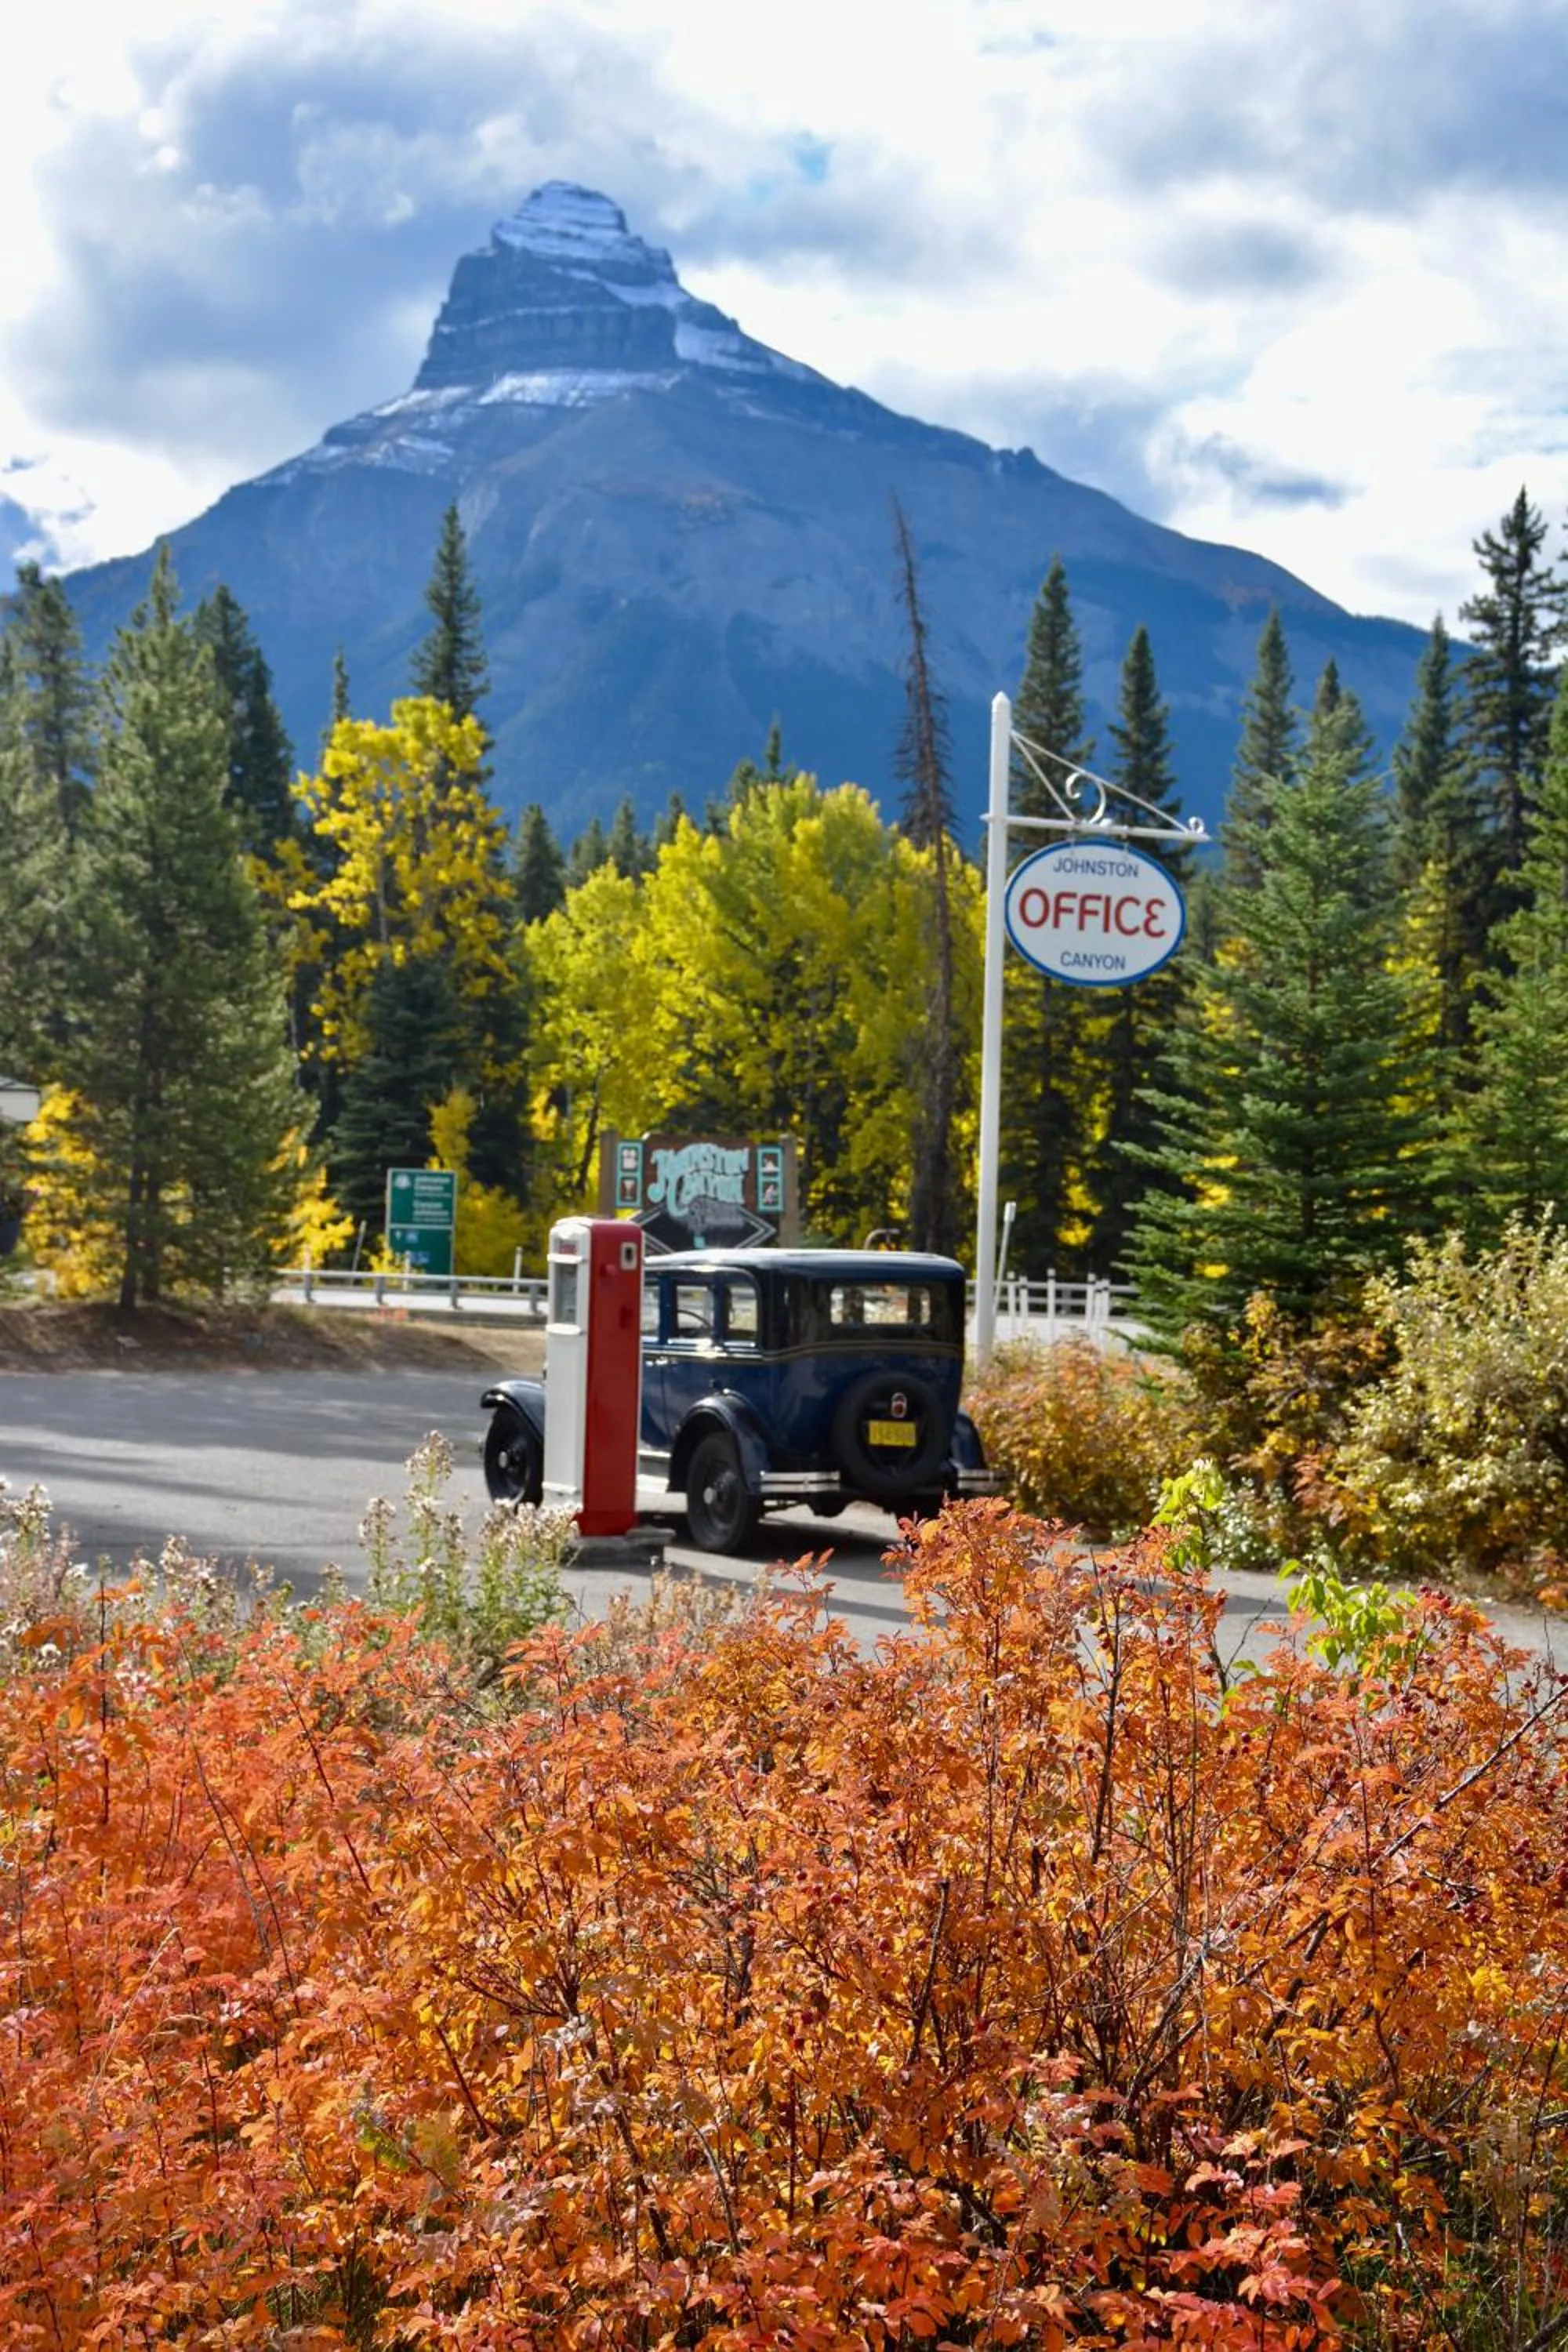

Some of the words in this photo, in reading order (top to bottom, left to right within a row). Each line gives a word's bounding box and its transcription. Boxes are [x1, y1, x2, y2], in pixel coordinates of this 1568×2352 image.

[1053, 857, 1139, 878] JOHNSTON
[1018, 887, 1167, 938] OFFICE
[1060, 951, 1127, 971] CANYON
